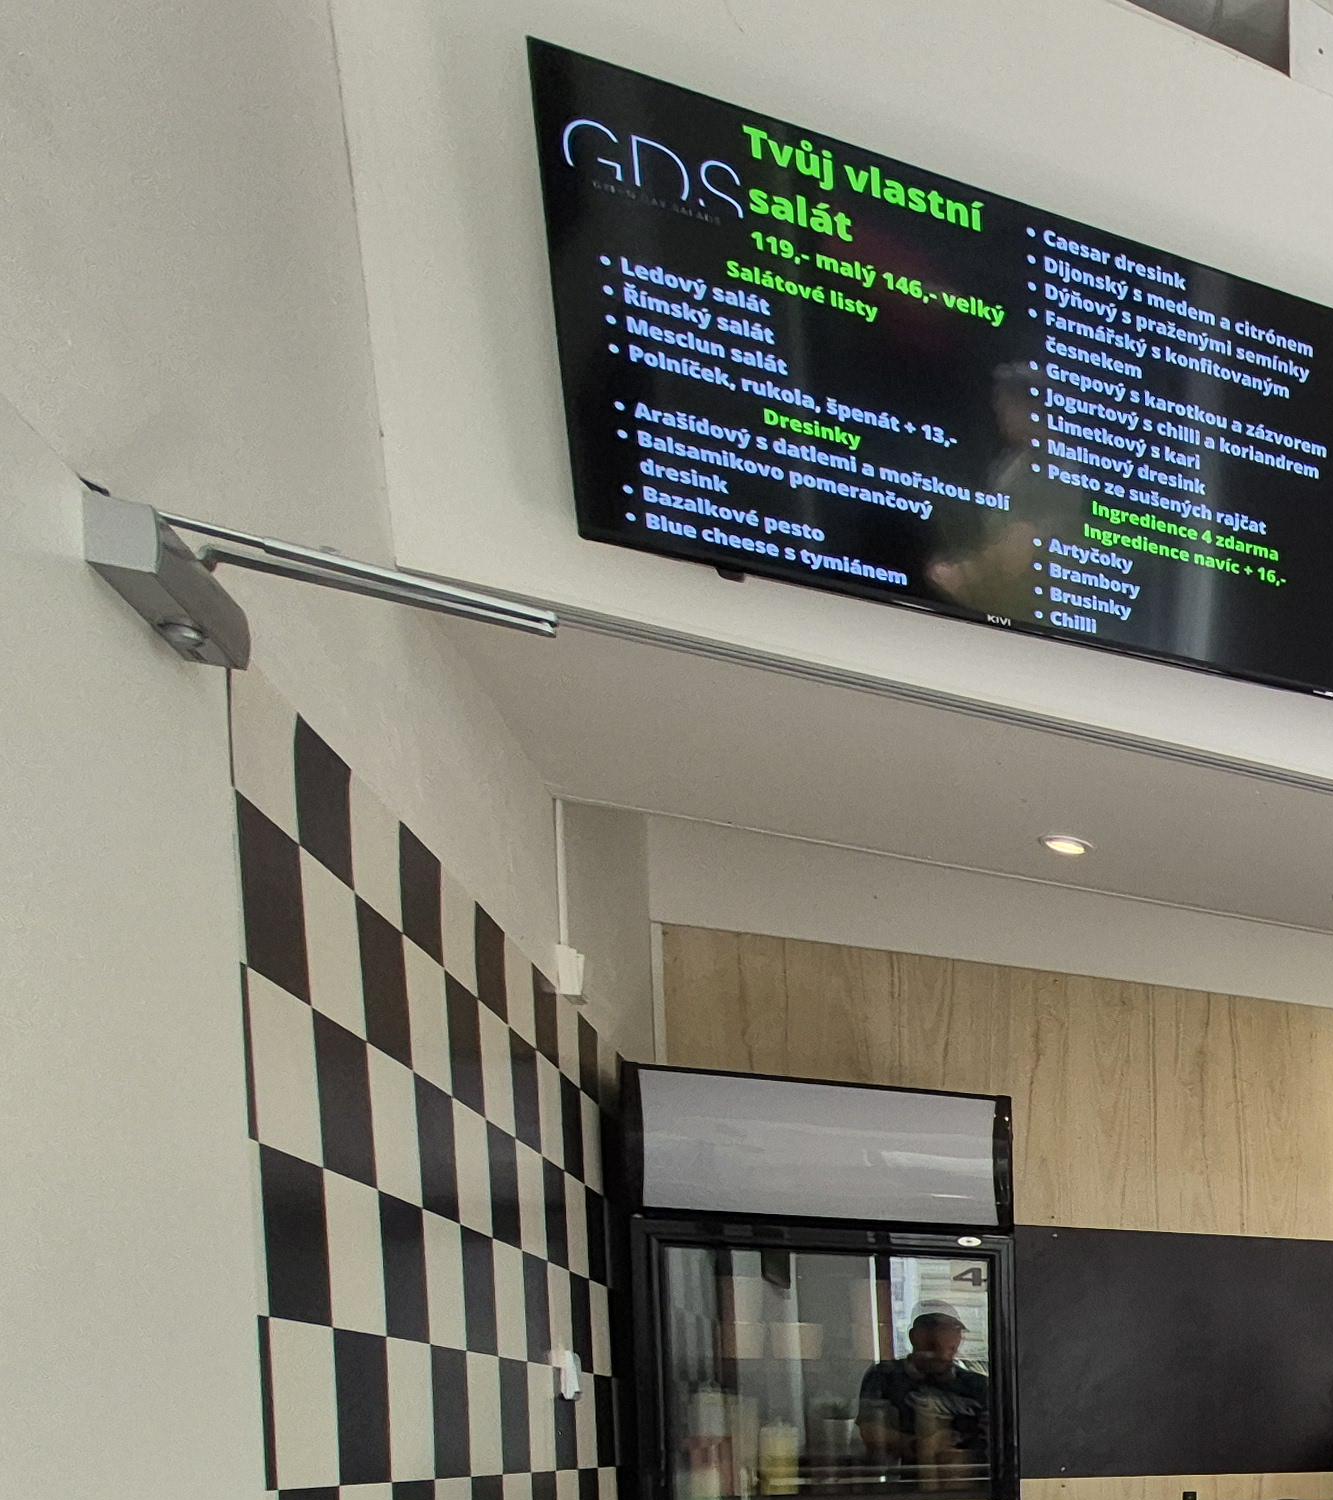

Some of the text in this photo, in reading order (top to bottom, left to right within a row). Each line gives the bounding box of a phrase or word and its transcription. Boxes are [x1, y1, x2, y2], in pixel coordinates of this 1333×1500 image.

[562, 118, 744, 220] GDS
[742, 124, 985, 232] Tvůj vlastní
[748, 188, 854, 242] salát
[620, 256, 771, 316] Ledový salát
[750, 231, 1005, 328] 119,- malý 146,- velký
[1042, 229, 1186, 291] Caesar dresink
[622, 282, 776, 345] Římský salát
[726, 260, 878, 323] Salátové listy
[1043, 255, 1314, 358] Dijonský s medem a citrónem
[626, 315, 788, 376] Mesclun salát
[628, 344, 958, 448] Polníček, rukola, špenát + 13,-
[634, 402, 1011, 512] Arašídový s datlemi a mořskou solí
[763, 408, 862, 451] Dresinky
[1047, 413, 1201, 470] Limetkový s kari
[636, 430, 934, 520] Balsamikovo pomerančový
[639, 458, 729, 495] dresink
[1047, 438, 1206, 496] Malinový dresink
[642, 485, 826, 542] Bazalkové pesto
[1092, 500, 1279, 562] Ingredience 4 zdarma
[645, 512, 908, 586] Blue cheese s tymiánem
[1048, 538, 1134, 575] Artyčoky
[1084, 522, 1286, 587] Ingredience navíc + 16,-
[1049, 562, 1141, 600] Brambory
[1049, 586, 1132, 621] Brusinky
[987, 612, 1012, 627] KIVI
[1049, 610, 1097, 634] Chilli
